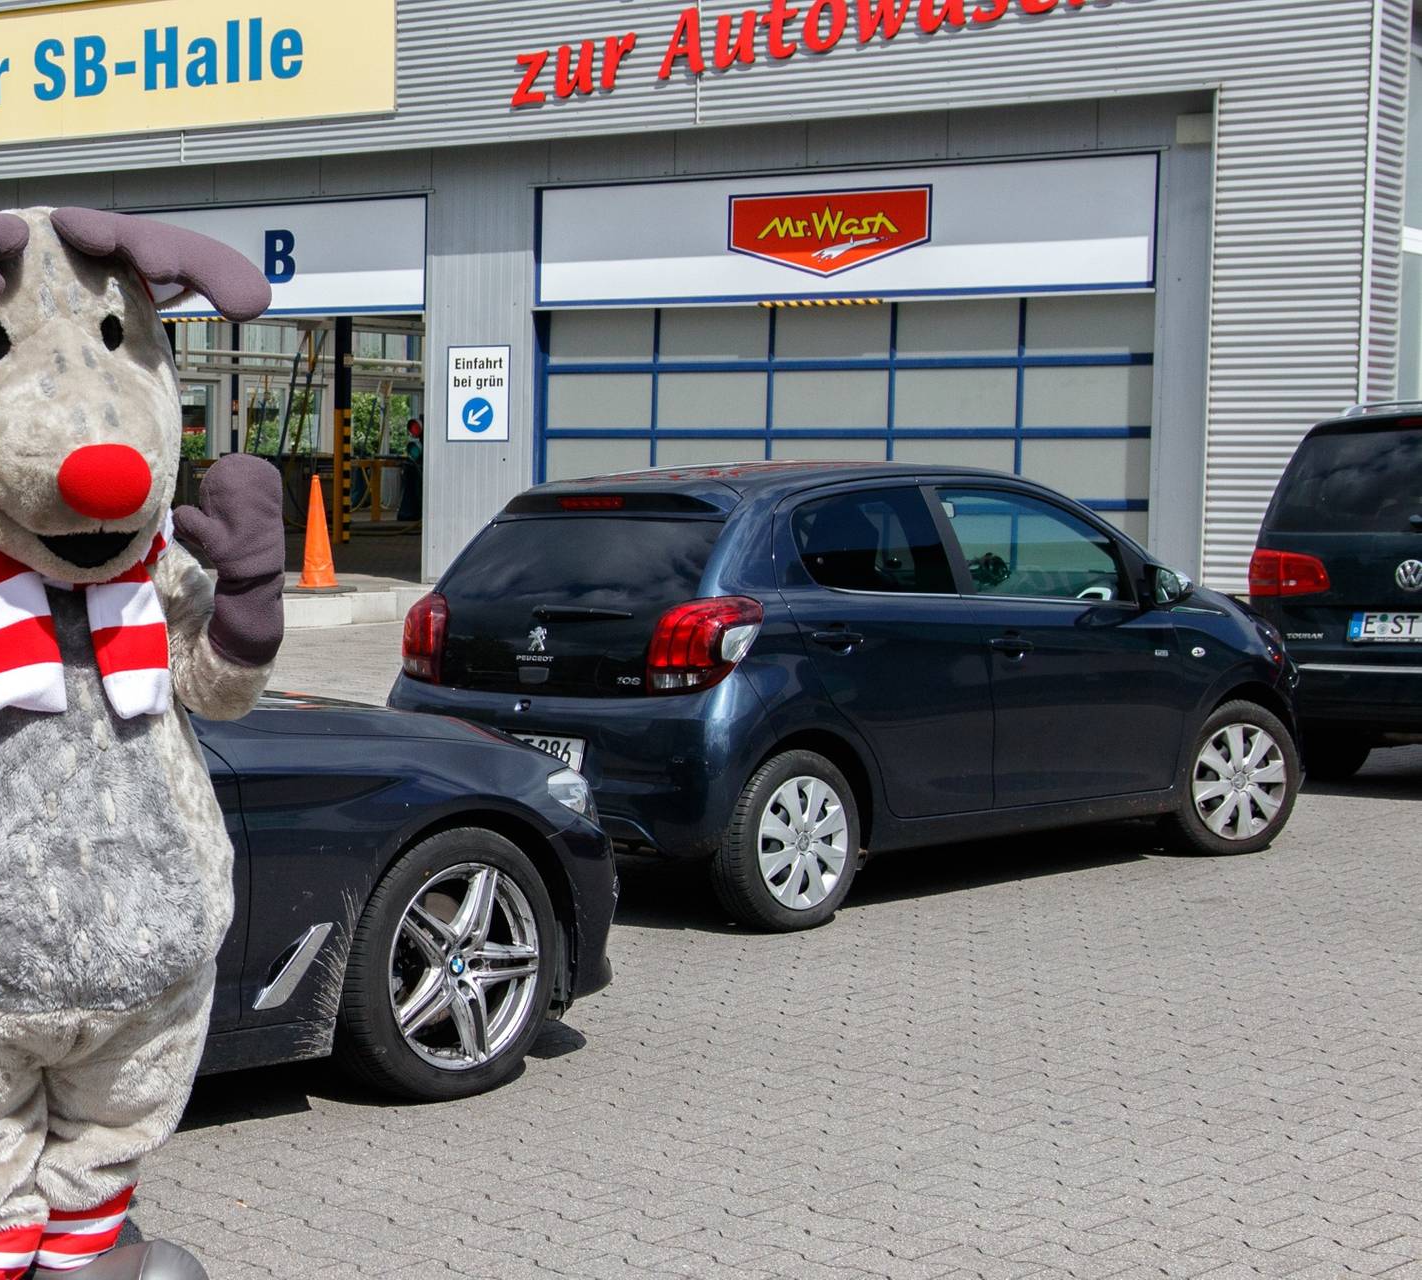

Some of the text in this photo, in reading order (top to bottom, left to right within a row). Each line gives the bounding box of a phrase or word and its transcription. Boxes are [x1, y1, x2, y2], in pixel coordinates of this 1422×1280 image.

[33, 17, 303, 102] SB-Halle
[511, 0, 1086, 108] zur Autow
[264, 228, 296, 284] B
[453, 375, 504, 390] bei grün
[455, 357, 503, 370] Einfahrt
